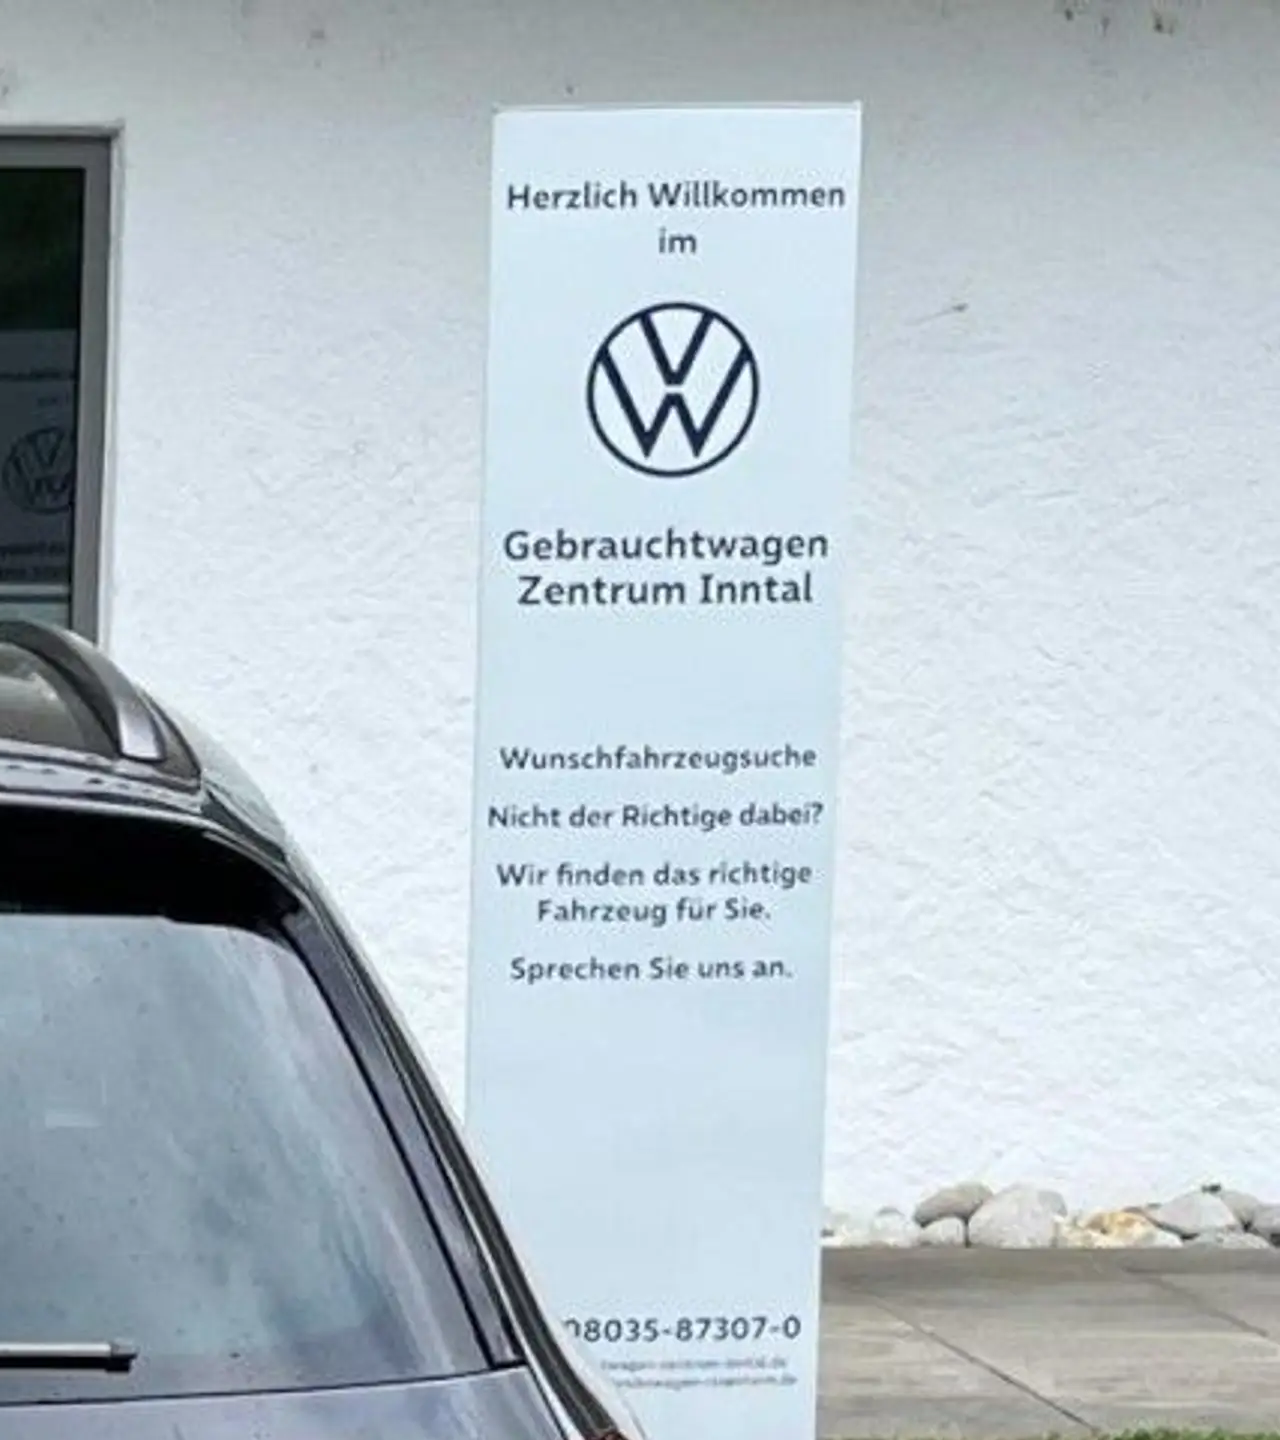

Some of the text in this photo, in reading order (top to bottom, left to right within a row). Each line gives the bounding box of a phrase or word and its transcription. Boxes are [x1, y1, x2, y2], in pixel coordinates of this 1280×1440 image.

[507, 179, 845, 211] Herzlich Willkommen
[657, 226, 698, 255] im
[503, 527, 829, 567] Gebrauchtwagen
[517, 570, 813, 606] Zentrum Inntal
[499, 743, 817, 775] Wunschfahrzeugsuche
[487, 801, 824, 833] Nicht der Richtige dabei?
[496, 860, 813, 891] Wir finden das richtige
[537, 896, 771, 928] Fahrzeug für Sie.
[510, 956, 792, 985] Sprechen Sie uns an.
